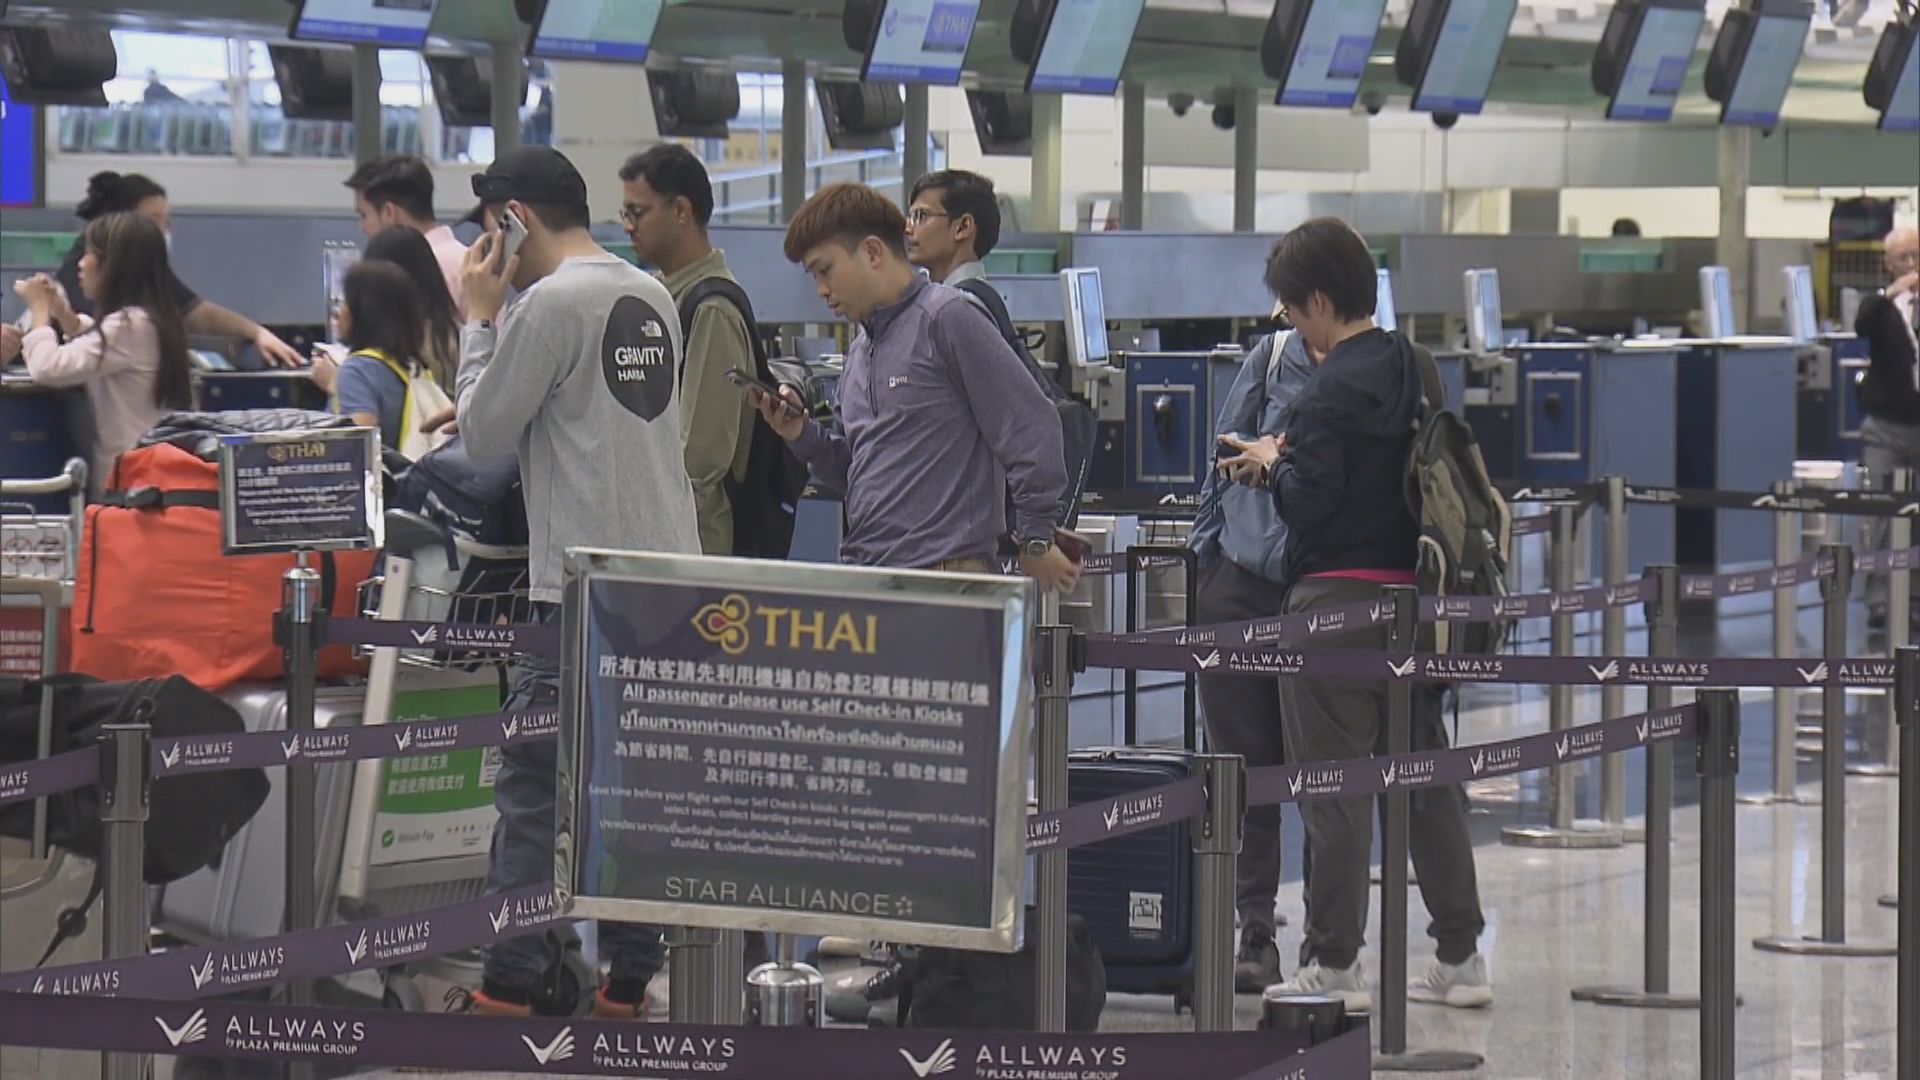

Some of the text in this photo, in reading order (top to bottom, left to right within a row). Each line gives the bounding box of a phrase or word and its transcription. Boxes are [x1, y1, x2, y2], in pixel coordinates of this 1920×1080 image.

[614, 345, 665, 366] GRAVITY
[287, 441, 326, 458] THAI
[446, 627, 515, 641] ALLWAYS
[755, 605, 878, 654] THAI
[1230, 652, 1304, 666] ALLWAYS
[1425, 659, 1503, 672] ALLWAYS
[1629, 662, 1709, 676] ALLWAYS
[1839, 663, 1896, 676] ALLWA
[622, 683, 964, 724] All passenger please use Self Check-in Kiosks
[1652, 713, 1682, 730] ALLWAYS
[416, 723, 458, 740] ALLWAYS
[1571, 729, 1604, 747] ALLWAYS
[185, 741, 233, 757] ALLWAYS
[304, 733, 350, 749] ALLWAYS
[1487, 746, 1521, 762] ALLWAYS
[1399, 760, 1435, 776] ALLWAYS
[0, 770, 28, 787] WAYS
[1306, 769, 1344, 786] ALLWAYS
[1123, 793, 1162, 817] ALLWAYS
[1026, 820, 1060, 839] LLWAYS
[515, 892, 553, 915] ALLWA
[665, 876, 890, 916] STAR ALLIANCE
[374, 919, 430, 948] ALLWAYS
[221, 946, 284, 972] ALLWAYS
[53, 970, 120, 995] ALLWAYS
[226, 1015, 365, 1041] ALLWAYS
[236, 1039, 270, 1051] PLAZA
[273, 1041, 320, 1054] PREMIUM
[323, 1043, 358, 1055] GROUP
[593, 1033, 735, 1057] ALLWAYS
[976, 1044, 1127, 1066] ALLWAYS
[603, 1056, 638, 1069] PLAZA
[641, 1058, 689, 1071] PREMIUM
[692, 1060, 728, 1072] GROUP
[987, 1068, 1024, 1080] PLAZA
[1026, 1070, 1079, 1080] PREMIUM
[1081, 1070, 1120, 1080] GROUP
